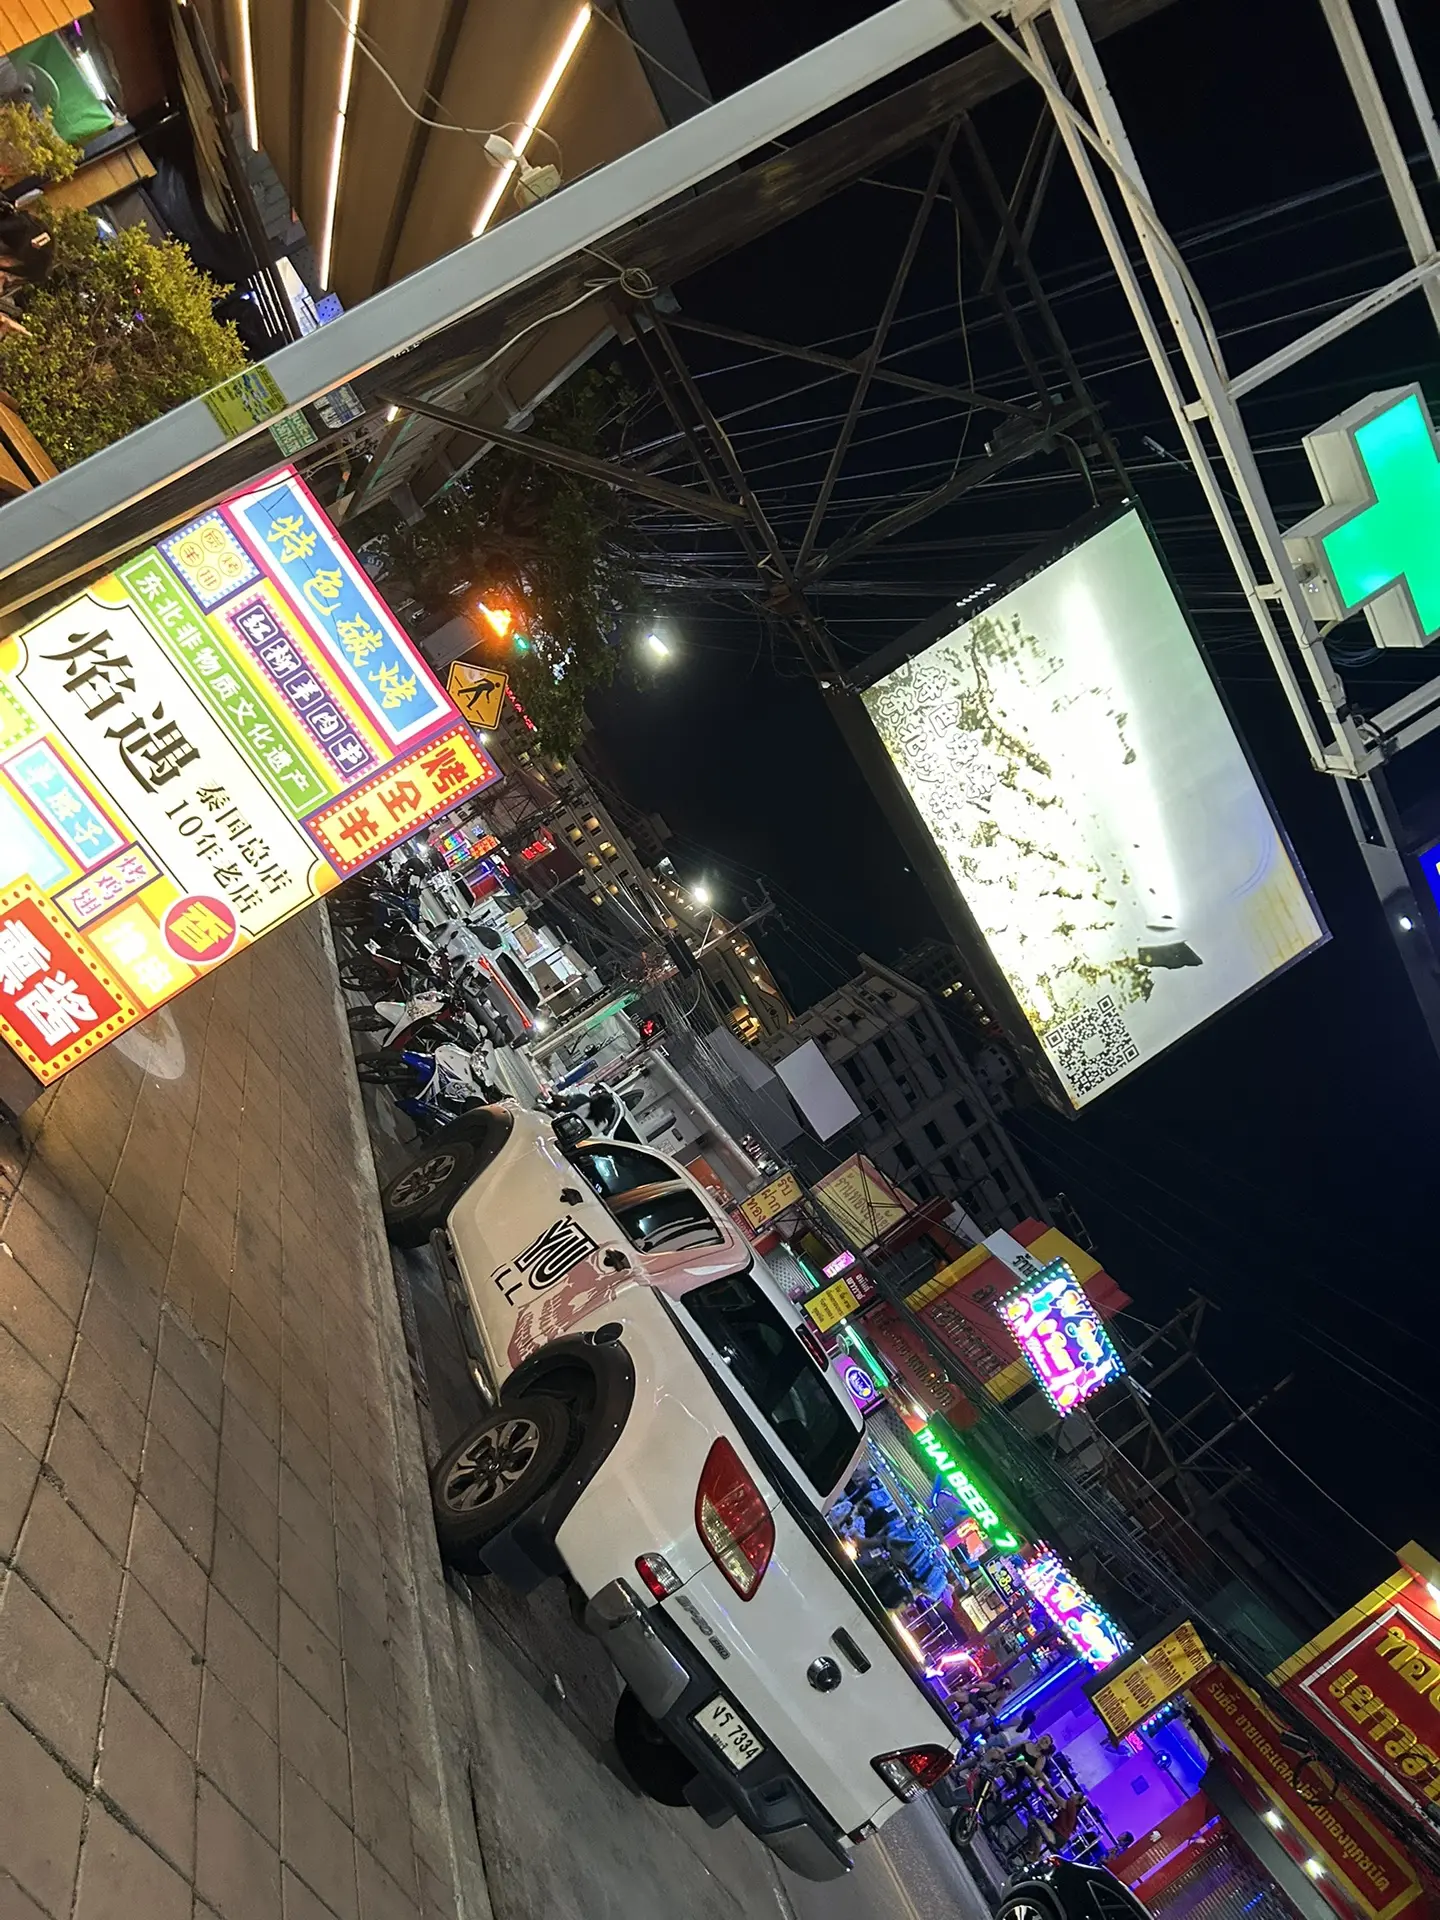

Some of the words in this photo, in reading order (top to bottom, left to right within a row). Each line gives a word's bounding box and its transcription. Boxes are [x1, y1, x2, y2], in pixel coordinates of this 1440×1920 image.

[265, 513, 414, 711] 特色碳烤
[40, 633, 204, 796] 焰遇
[135, 570, 310, 798] 东北非物质文化遗产
[241, 609, 367, 773] 红柳羊肉串
[194, 778, 294, 896] 泰国总店
[331, 745, 471, 855] 烤全羊
[70, 854, 148, 917] 烤鸡翅
[171, 895, 234, 951] 香
[747, 1198, 767, 1223] ทอง
[761, 1188, 782, 1213] ฝาก
[777, 1177, 794, 1196] รับ
[917, 1428, 955, 1472] THAI
[946, 1471, 999, 1530] BEER
[995, 1531, 1019, 1550] 7
[728, 1724, 759, 1759] 7334
